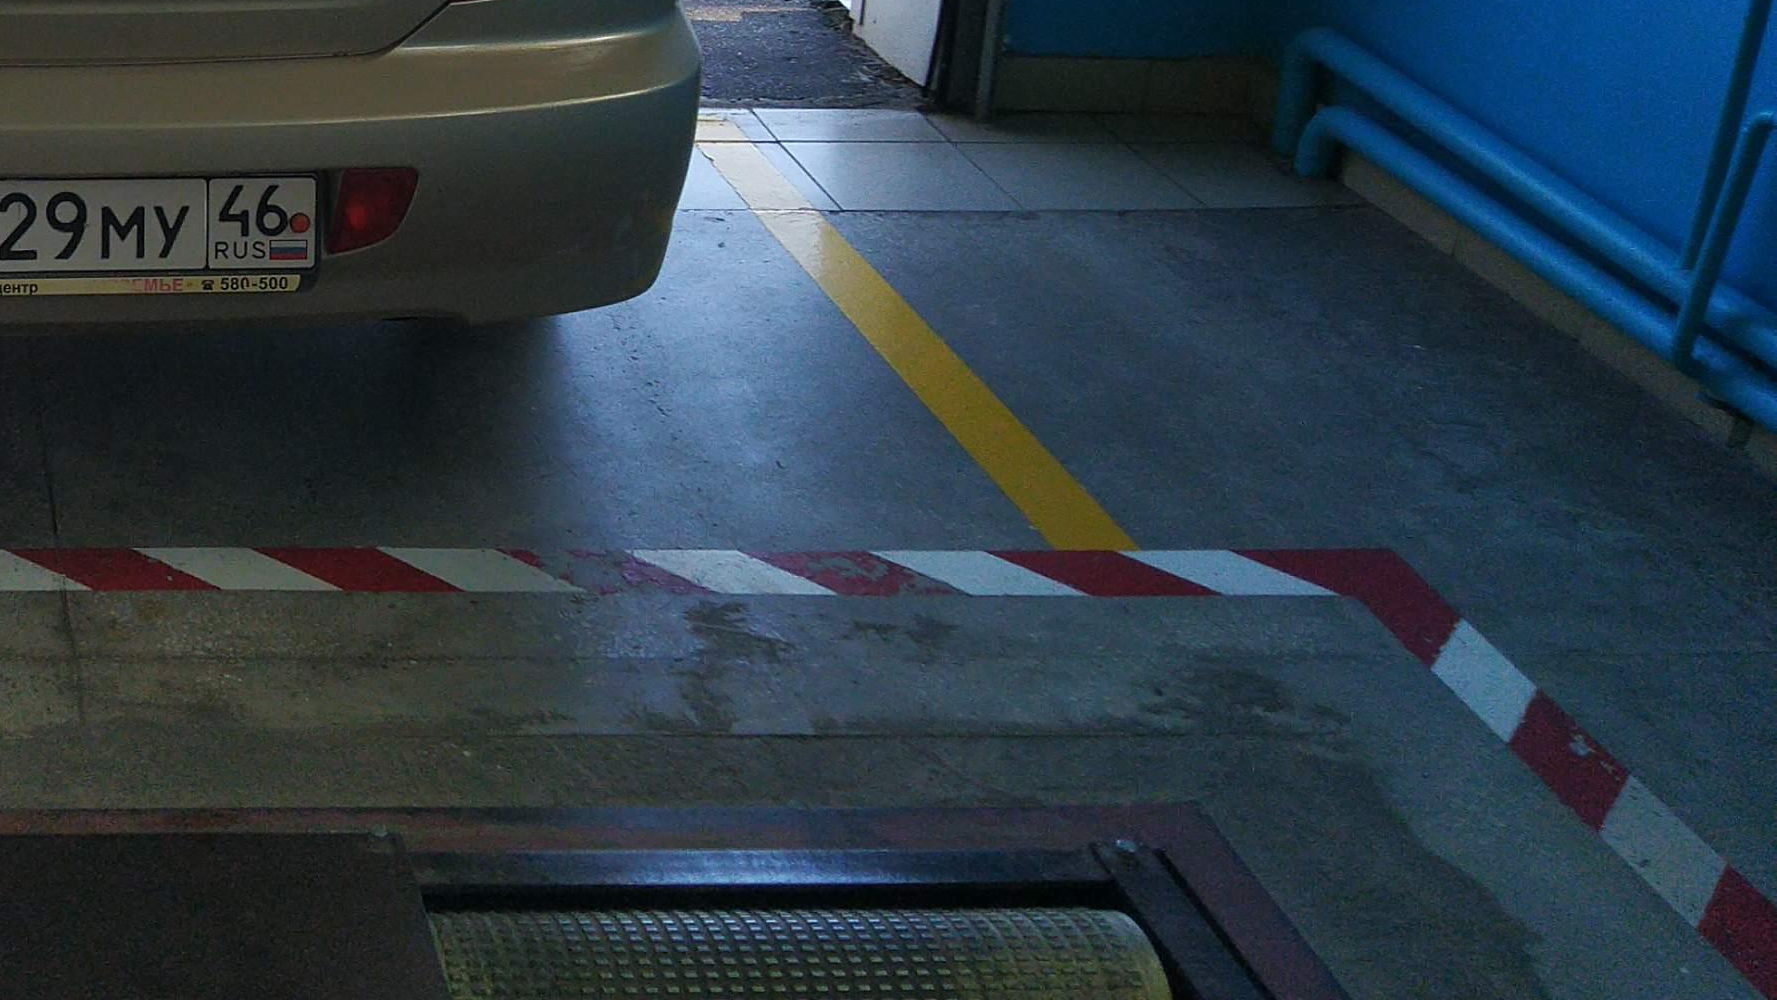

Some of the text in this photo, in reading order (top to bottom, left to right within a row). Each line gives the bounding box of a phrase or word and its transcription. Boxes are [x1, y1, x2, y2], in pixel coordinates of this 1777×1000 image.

[218, 184, 289, 237] 46
[214, 240, 266, 260] RUS
[221, 276, 288, 290] 580-500
